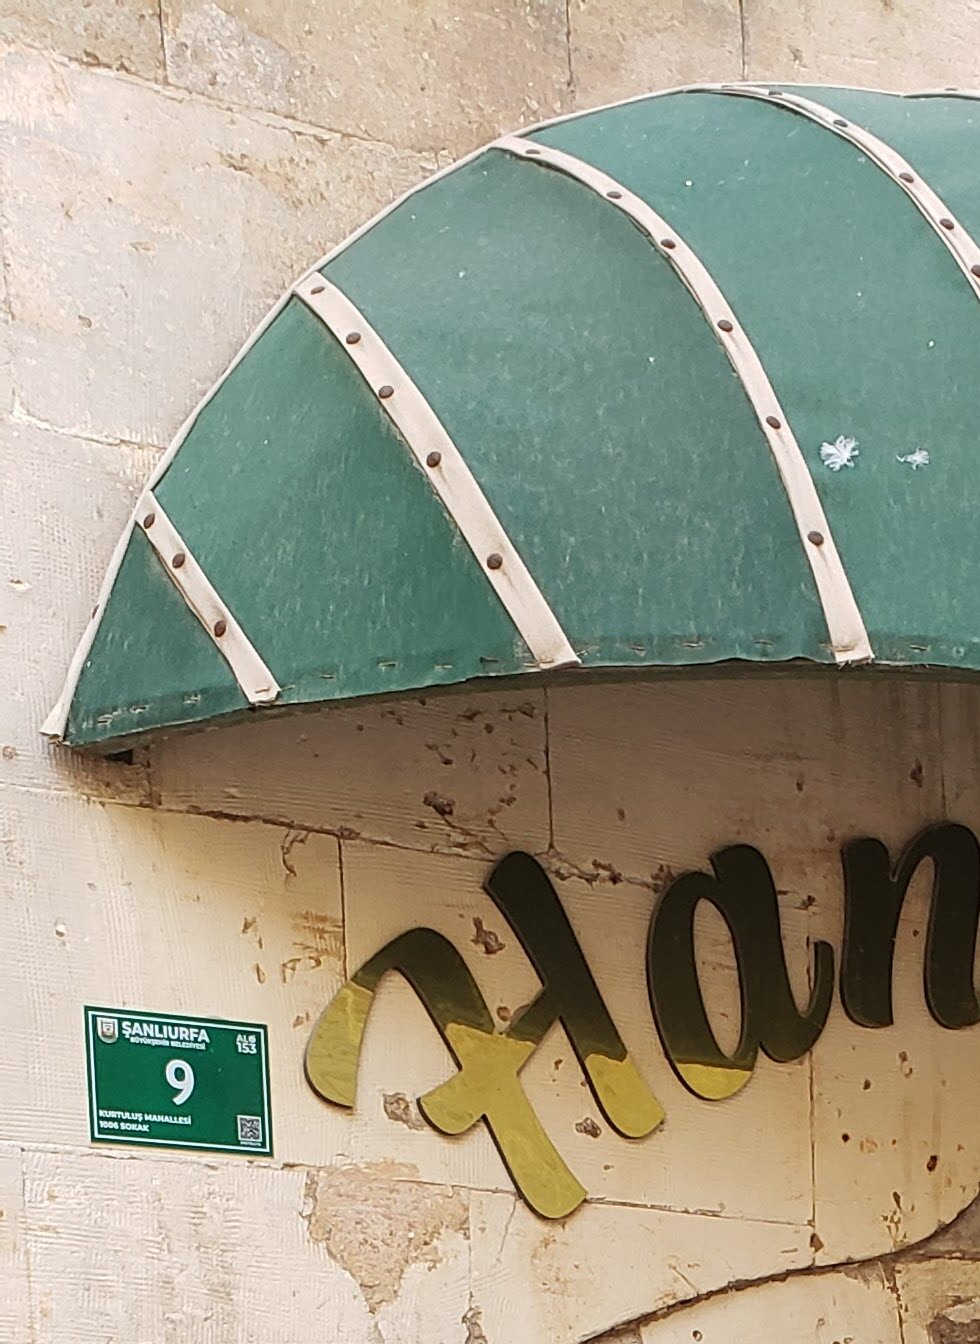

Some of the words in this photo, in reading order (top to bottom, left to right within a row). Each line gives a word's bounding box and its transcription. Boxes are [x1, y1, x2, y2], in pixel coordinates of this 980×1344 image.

[122, 1021, 210, 1043] ŞANLIURFA
[237, 1042, 257, 1054] 153
[165, 1059, 195, 1106] 9
[99, 1109, 143, 1122] KURTULUŞ
[144, 1113, 192, 1125] MAHALLESİ
[120, 1122, 150, 1132] SOKAK
